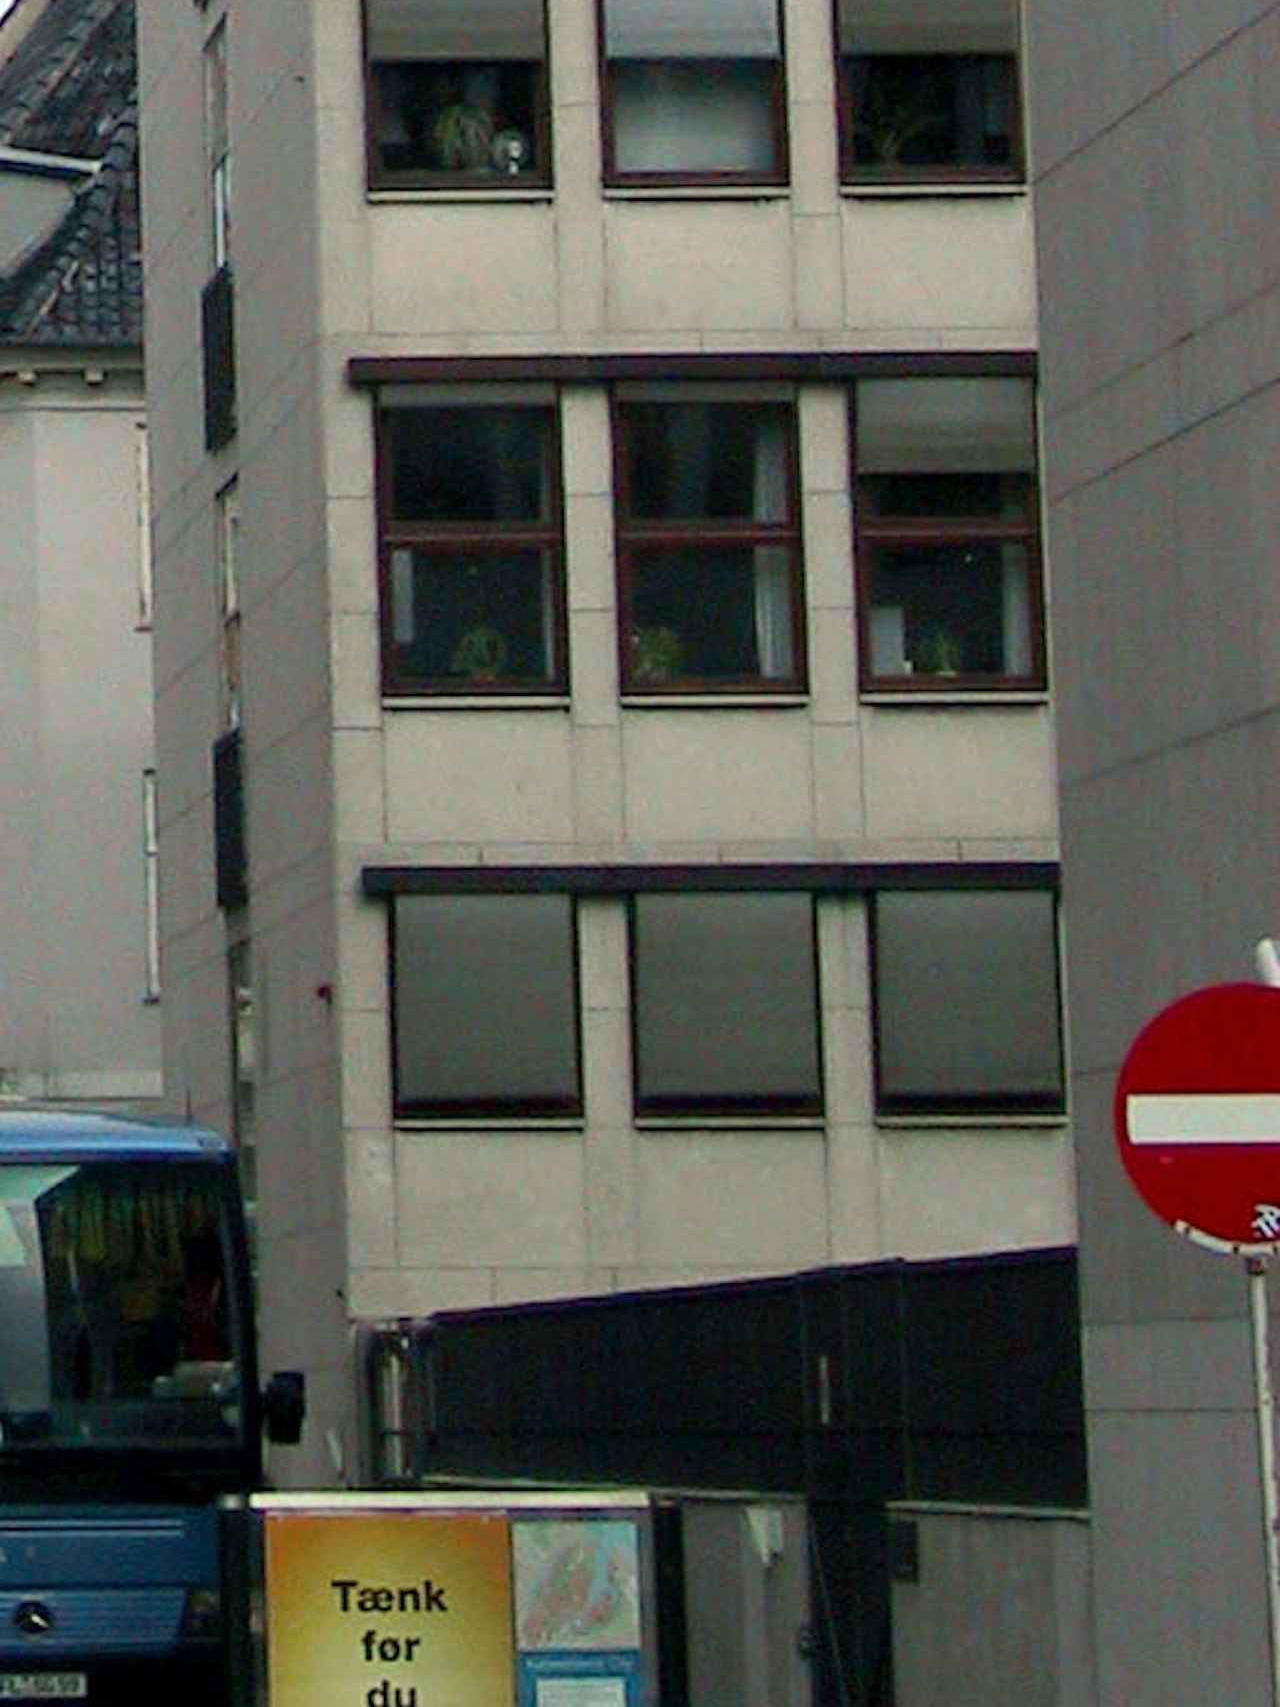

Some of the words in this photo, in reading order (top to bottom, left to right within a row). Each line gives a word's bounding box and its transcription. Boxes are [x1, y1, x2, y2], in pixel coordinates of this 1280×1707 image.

[330, 1579, 448, 1613] Tænk
[361, 1629, 421, 1663] før
[366, 1679, 417, 1707] du
